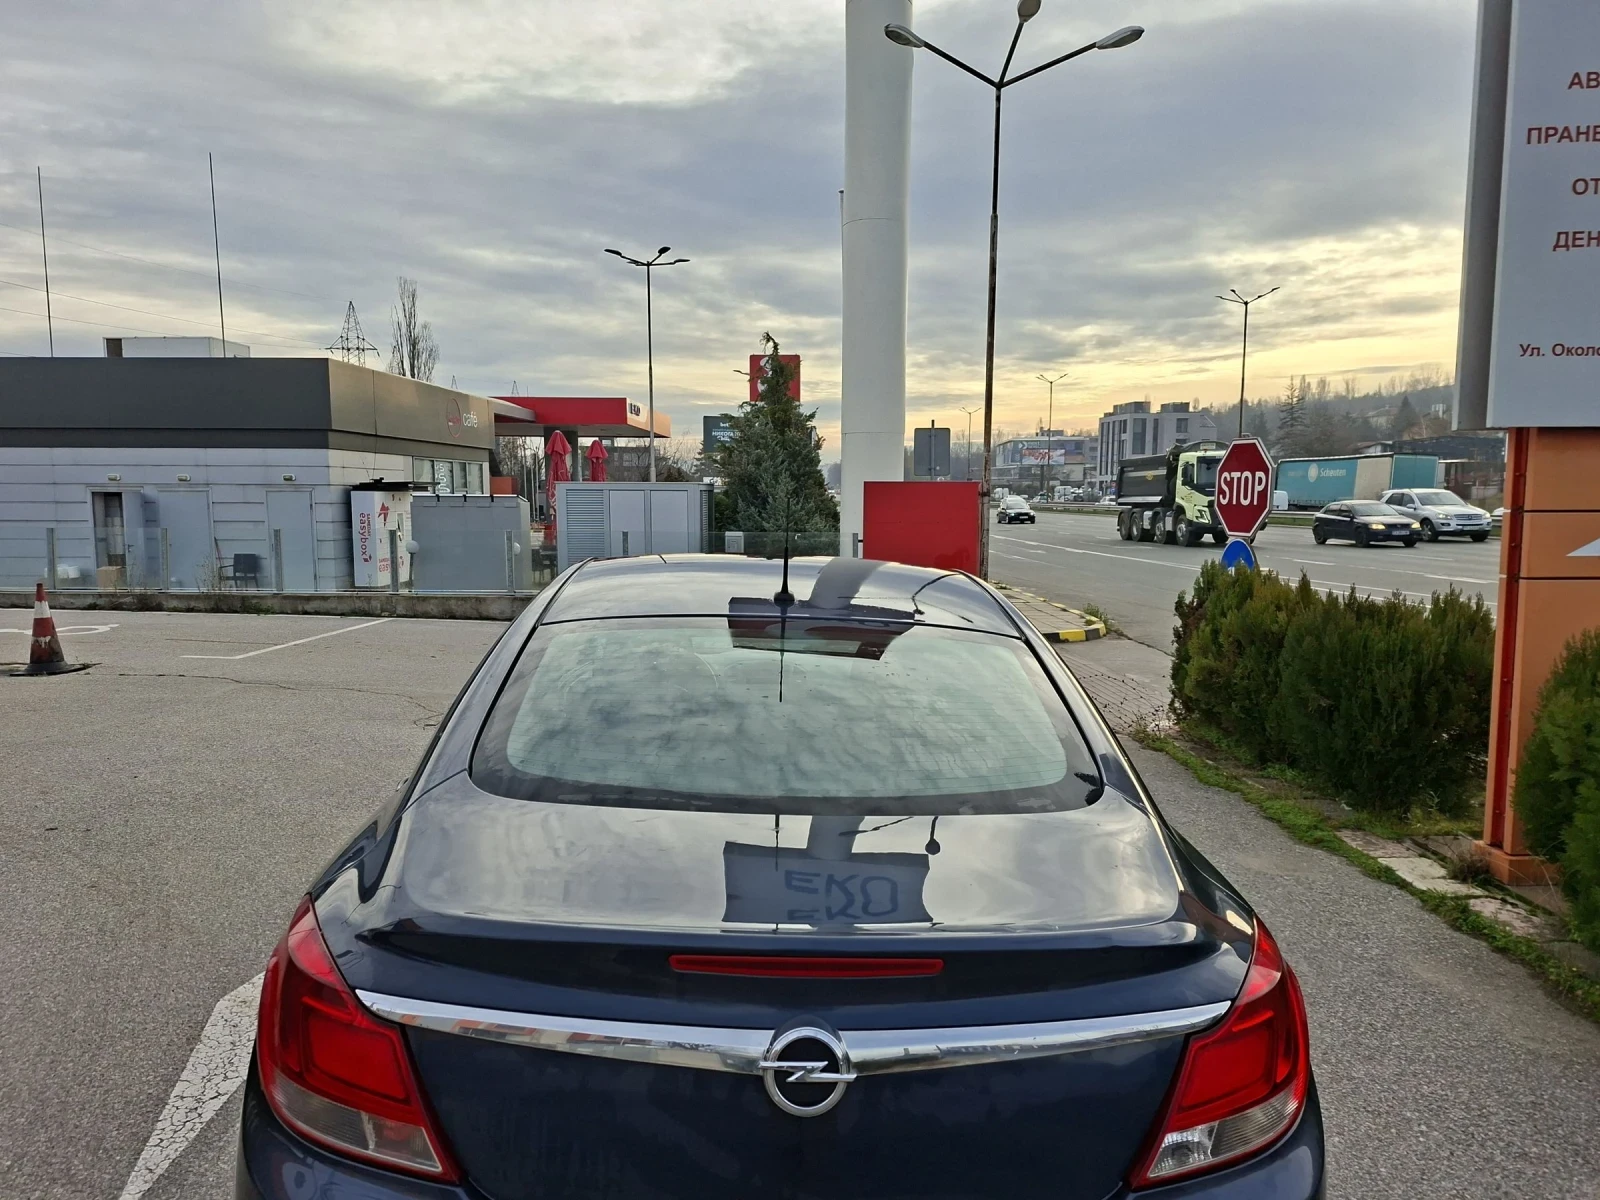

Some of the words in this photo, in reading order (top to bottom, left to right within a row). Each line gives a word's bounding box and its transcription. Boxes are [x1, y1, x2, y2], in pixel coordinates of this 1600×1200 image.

[1567, 71, 1600, 90] АВ
[1552, 230, 1600, 252] ДЕН
[1519, 343, 1545, 357] Ул.
[1219, 470, 1267, 506] STOP
[358, 512, 369, 556] easybox
